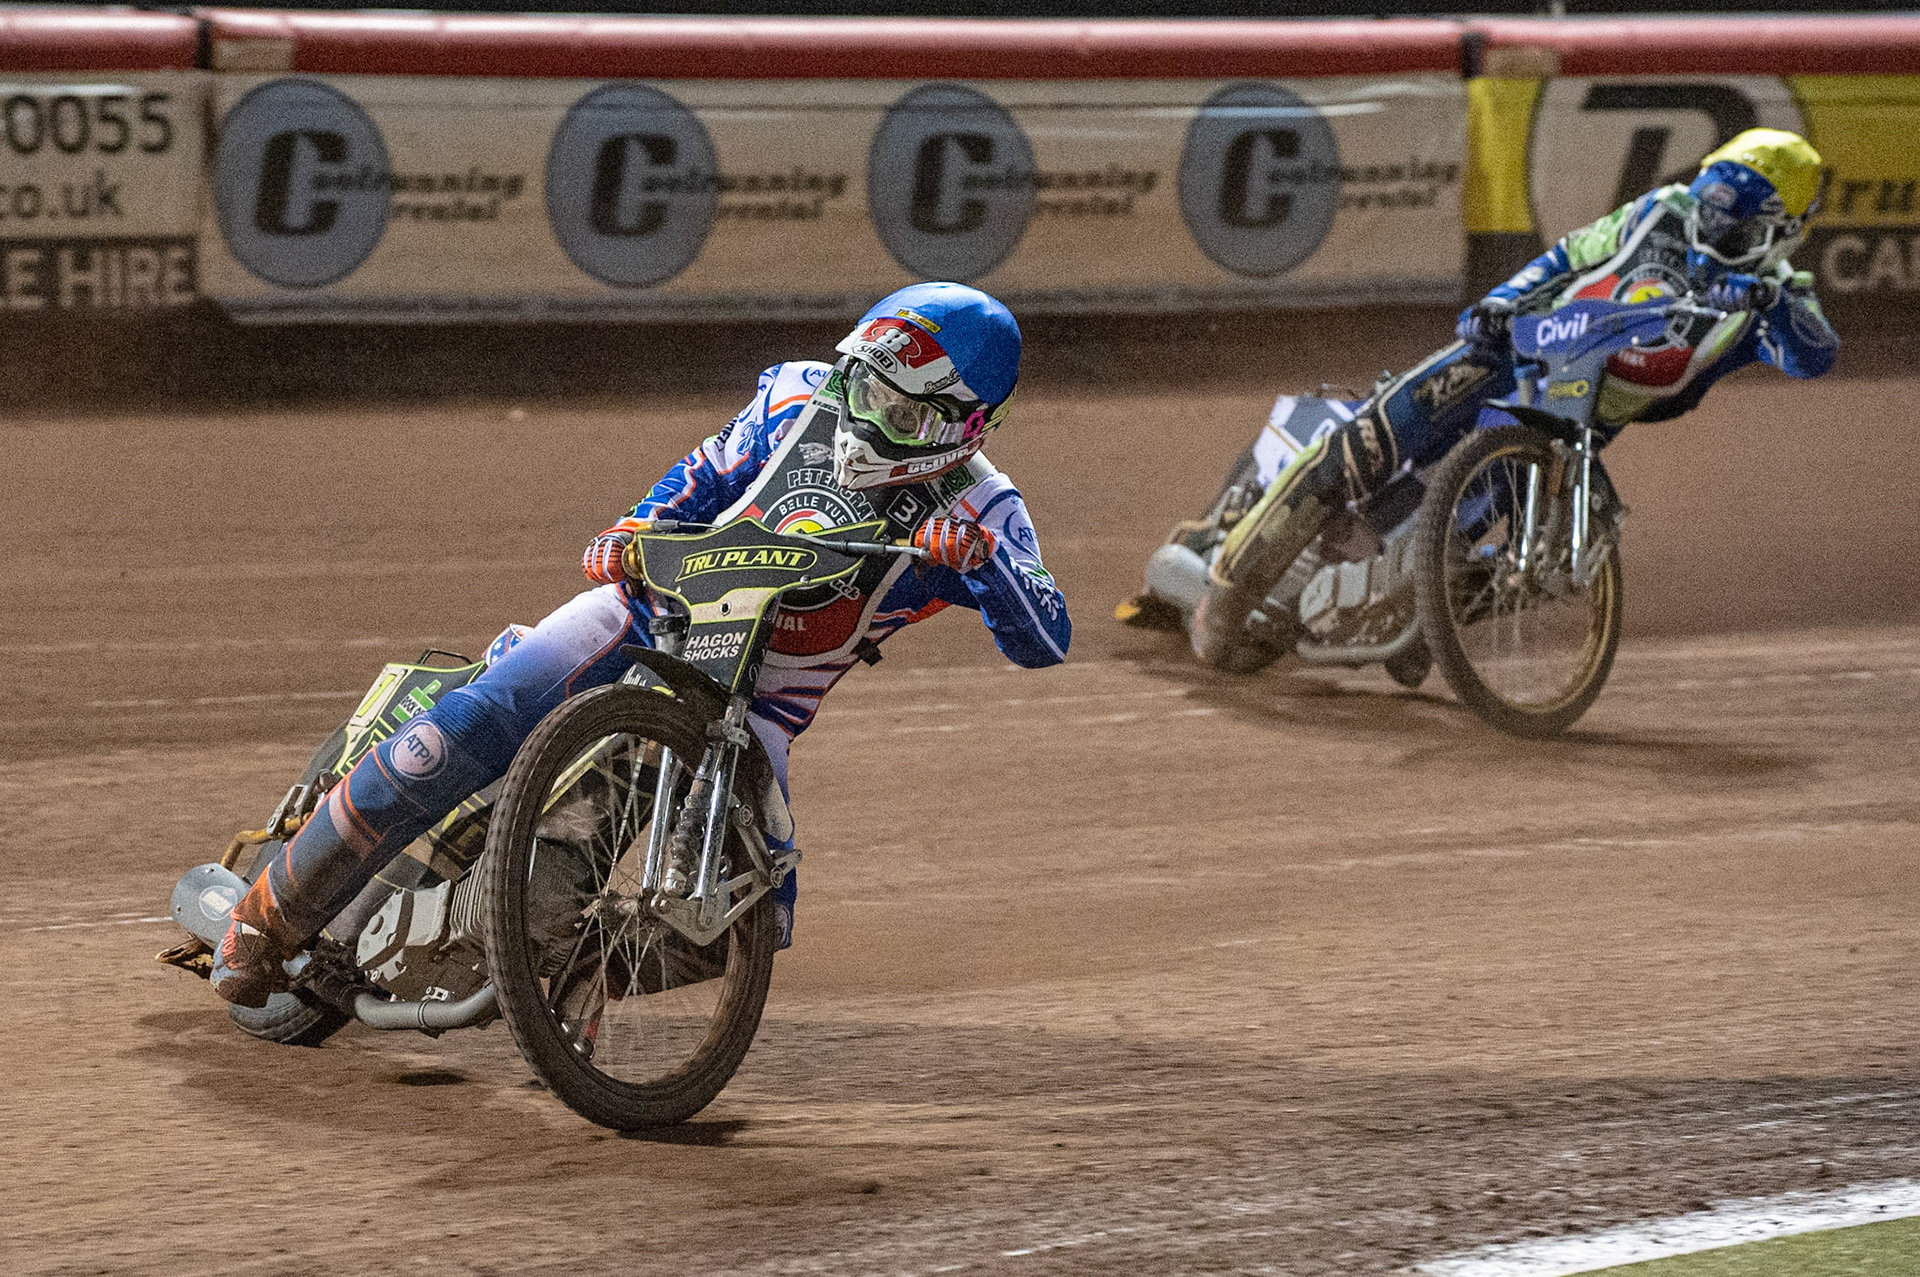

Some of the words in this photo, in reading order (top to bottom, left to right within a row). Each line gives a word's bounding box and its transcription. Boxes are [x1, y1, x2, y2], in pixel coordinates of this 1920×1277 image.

[60, 248, 197, 309] HIRE
[1821, 236, 1920, 292] CA
[1536, 312, 1589, 347] Civil
[859, 344, 894, 370] SHOEI
[778, 496, 820, 516] BELLE
[824, 501, 848, 527] VUE
[685, 553, 722, 575] TRU
[721, 550, 808, 567] PLANT
[682, 645, 740, 662] SHOCKS
[686, 632, 747, 650] HAGON
[404, 734, 434, 766] ATPI
